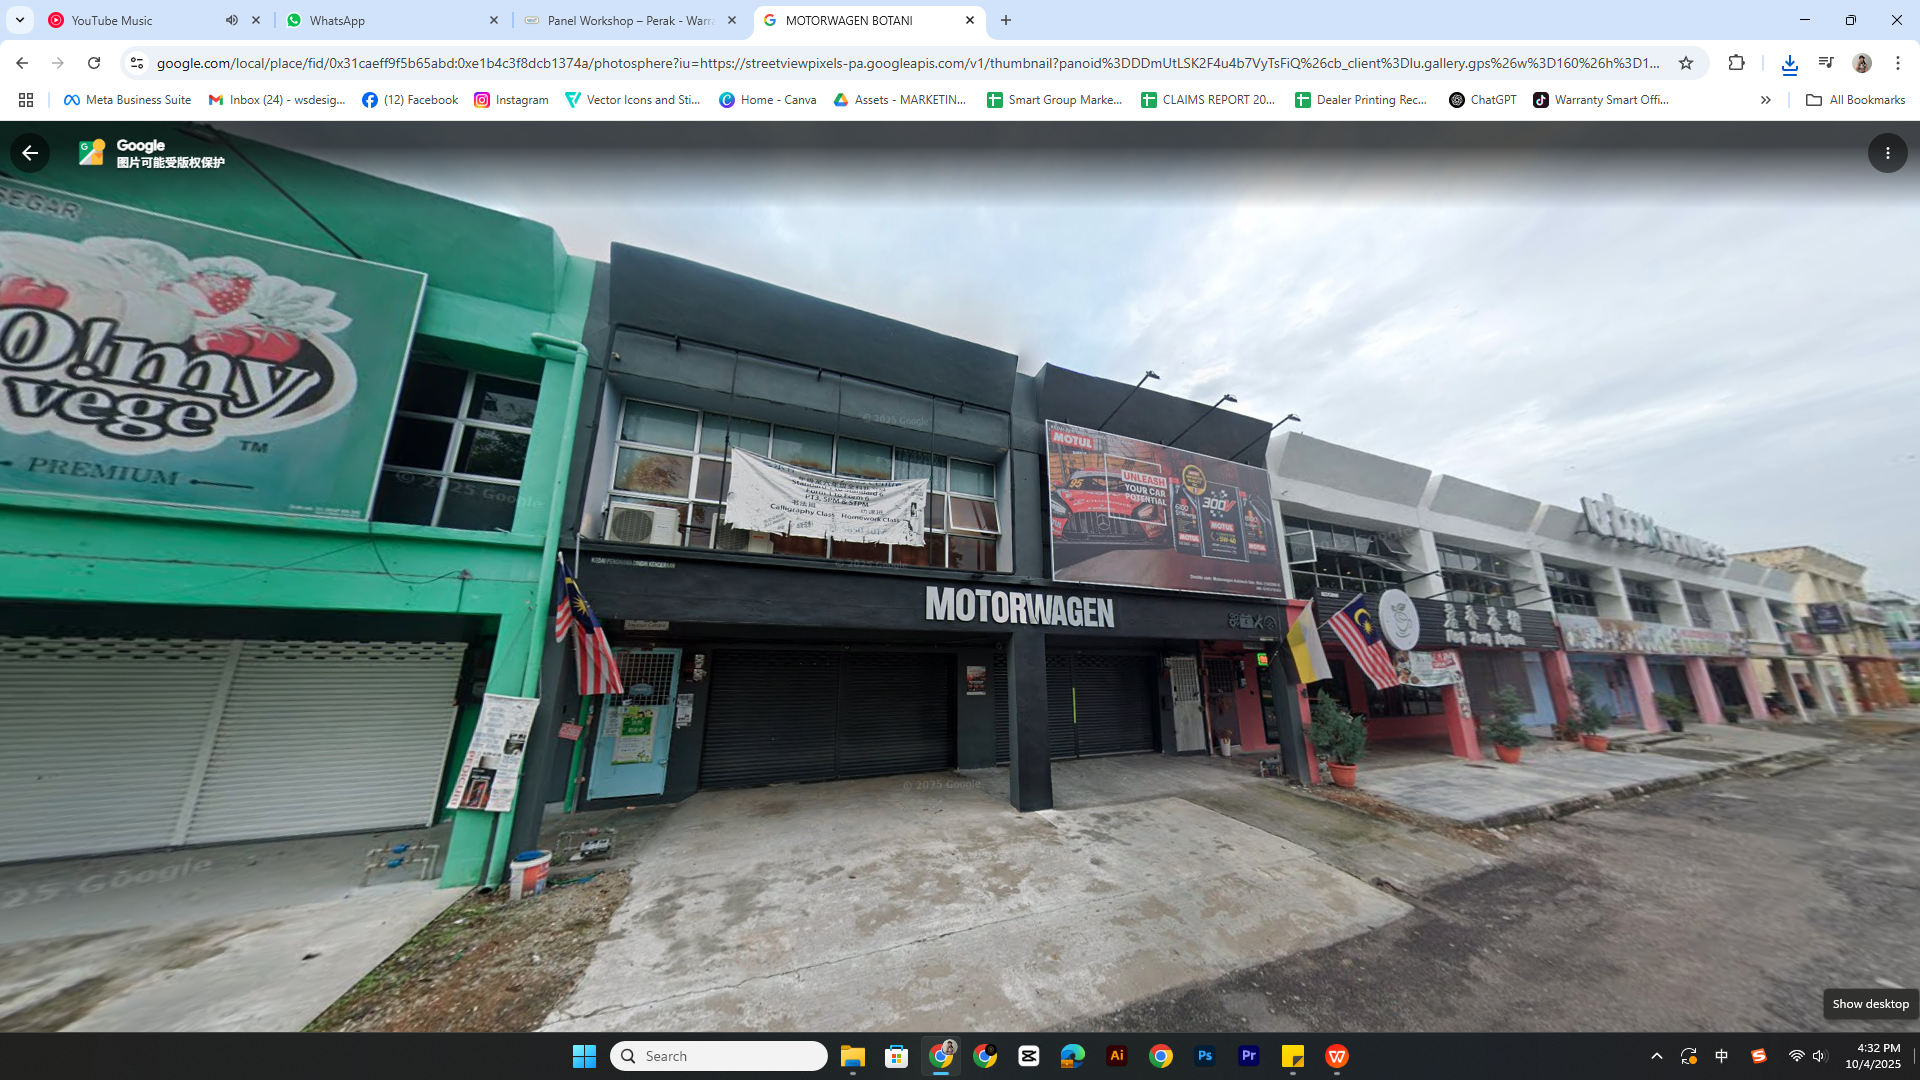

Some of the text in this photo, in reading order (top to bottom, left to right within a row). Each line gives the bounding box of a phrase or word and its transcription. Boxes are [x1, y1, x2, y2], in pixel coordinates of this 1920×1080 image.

[72, 15, 153, 26] YouTube Music
[309, 15, 366, 29] WhatsApp
[548, 15, 577, 26] Panel
[579, 15, 634, 29] Workshop
[646, 15, 676, 26] Perak
[786, 15, 913, 26] MOTORWAGEN BOTANI
[86, 94, 192, 105] Meta Business Suite
[230, 94, 261, 105] Inbox
[262, 94, 284, 107] (24)
[294, 94, 346, 108] wsdesig...
[384, 94, 459, 107] (12) Facebook
[496, 94, 549, 108] Instagram
[586, 94, 701, 105] Vector Icons and Sti...
[741, 94, 774, 105] Home
[784, 94, 817, 105] Canva
[854, 94, 889, 105] Assets
[900, 94, 967, 105] MARKETIN...
[1008, 94, 1123, 108] Smart Group Marke...
[1162, 94, 1275, 105] CLAIMS REPORT 20...
[1317, 94, 1427, 108] Dealer Printing Rec...
[1470, 94, 1518, 105] ChatGPT
[1554, 94, 1669, 108] Warranty Smart Offi...
[1829, 94, 1906, 105] All Bookmarks
[3, 376, 218, 441] vege
[1053, 431, 1093, 449] MOTUL
[27, 456, 182, 487] PREMIUM
[1069, 477, 1085, 488] 95
[1123, 471, 1166, 488] UNLEASH
[1124, 483, 1166, 498] YOUR CAR
[823, 496, 840, 505] SPM
[849, 499, 869, 508] STPM
[1125, 491, 1167, 506] POTENTIAL
[1202, 496, 1236, 513] 300V
[769, 503, 836, 518] Calligraphy Class
[840, 512, 882, 523] Homework
[1210, 521, 1234, 532] MOTUL
[1179, 533, 1200, 543] MOTUL
[926, 585, 1115, 628] MOTORWAGEN
[1832, 998, 1910, 1013] Show desktop
[1857, 1043, 1901, 1053] 4:32 PM
[646, 1050, 687, 1062] Search
[1198, 1050, 1213, 1061] Ps
[1242, 1049, 1257, 1061] Pr
[1715, 1048, 1728, 1064] 中
[1845, 1059, 1902, 1071] 10/4/2025
